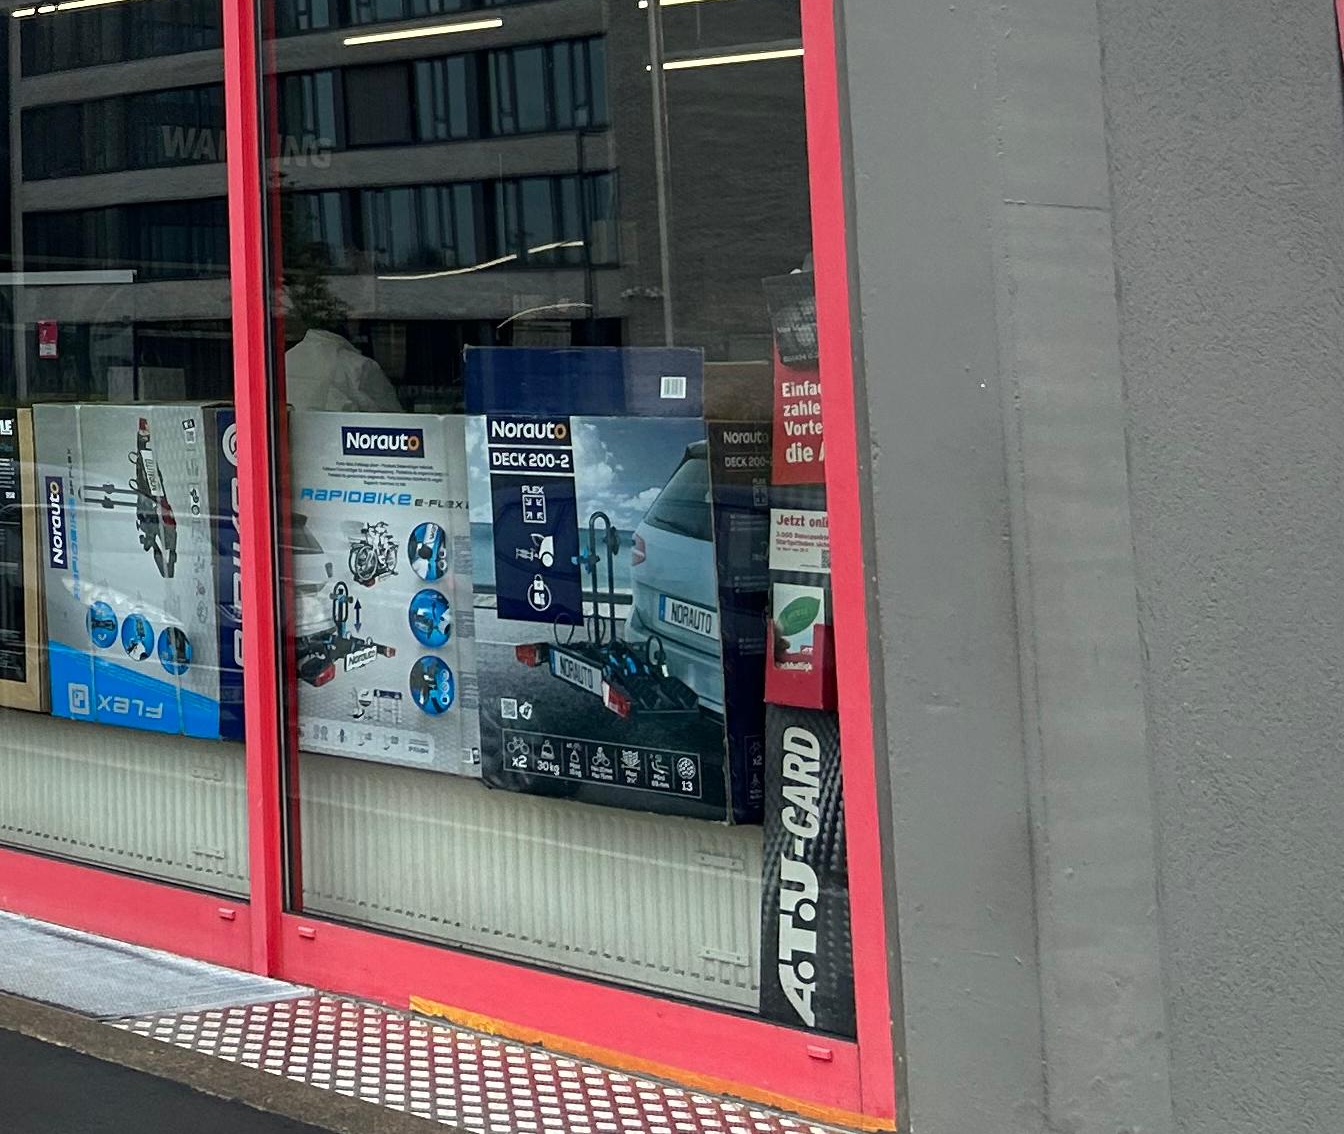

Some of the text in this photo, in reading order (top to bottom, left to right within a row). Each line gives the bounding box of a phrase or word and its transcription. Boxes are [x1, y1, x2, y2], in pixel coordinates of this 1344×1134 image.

[491, 420, 567, 440] Norauto
[723, 431, 769, 445] Norauto
[346, 431, 420, 451] Norauto
[492, 452, 570, 468] DECK 200-2
[785, 441, 814, 463] die
[724, 456, 771, 468] DECK 200-
[521, 485, 545, 495] FLEX
[51, 480, 64, 566] Norauto
[776, 514, 805, 527] Jetzt
[670, 600, 713, 634] NORAUTO
[559, 655, 595, 689] NORAUTO
[512, 754, 528, 769] x2
[681, 780, 694, 792] 13
